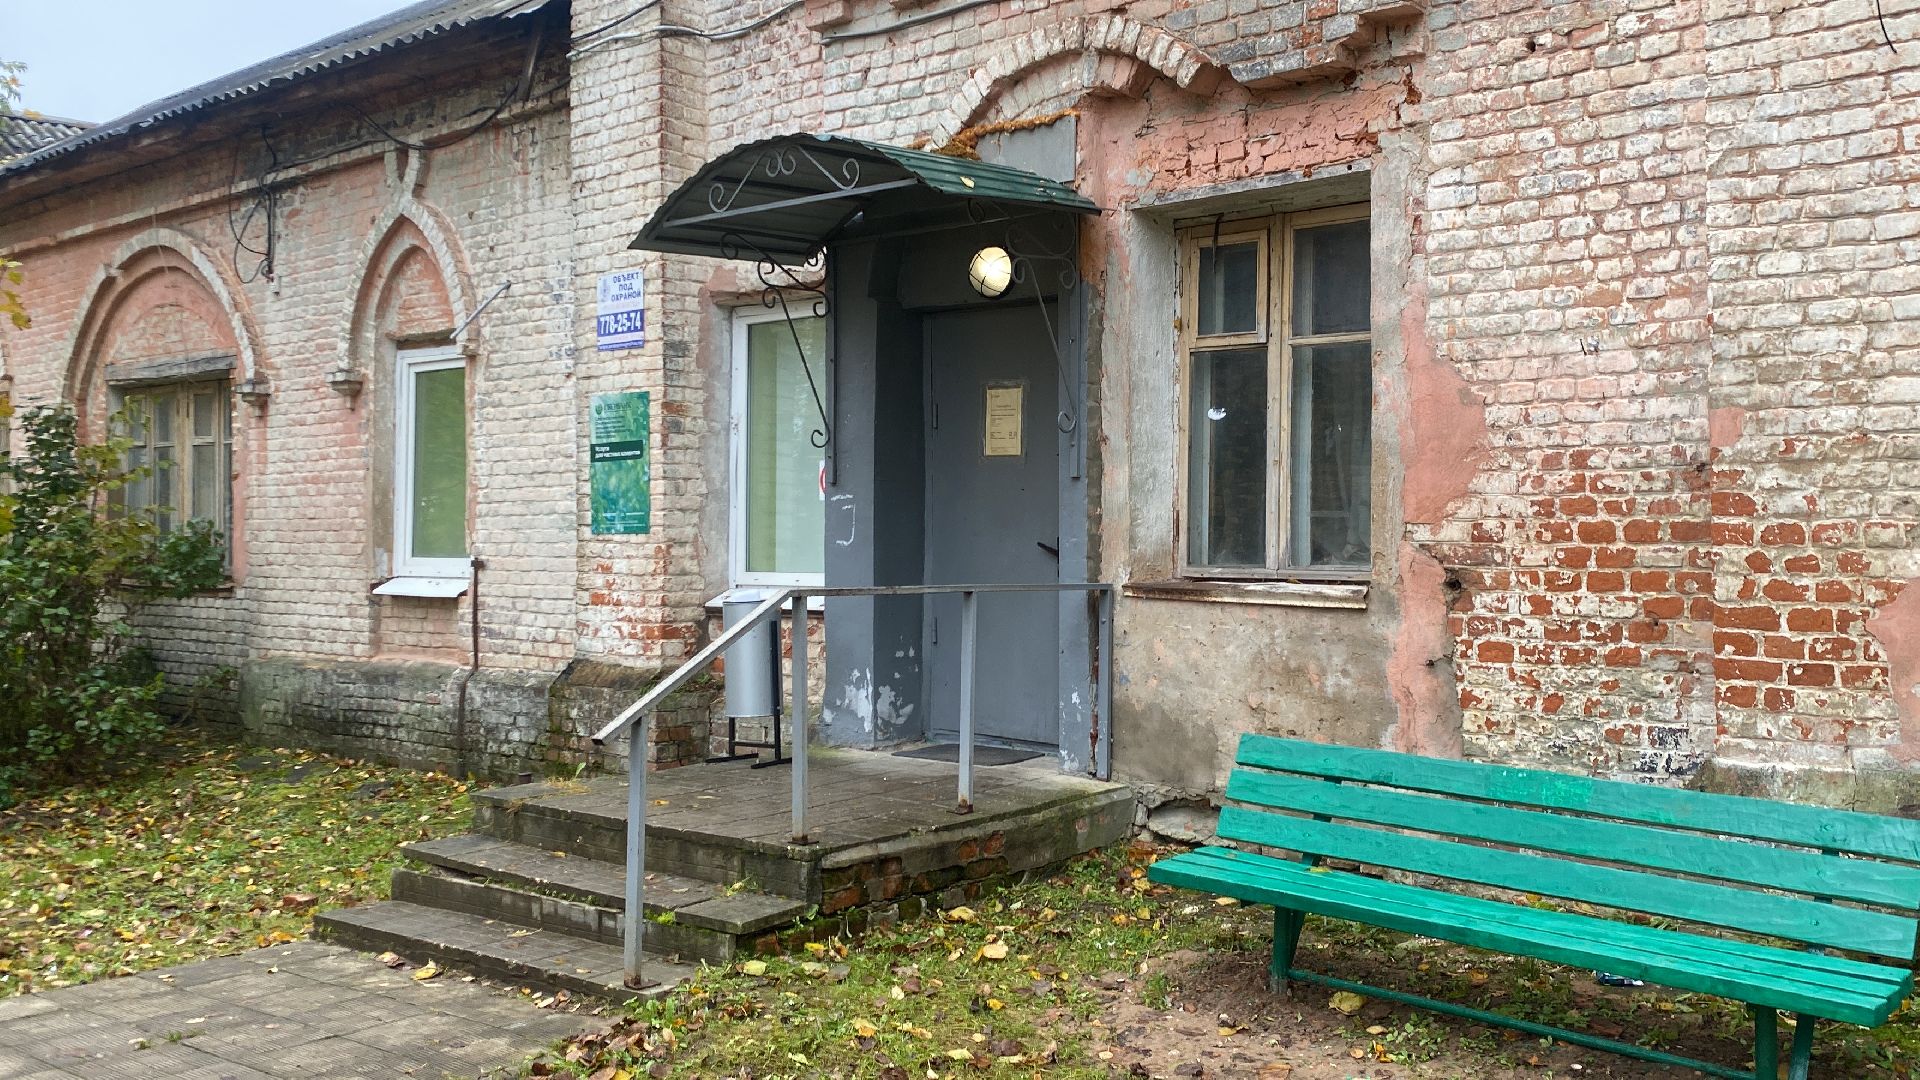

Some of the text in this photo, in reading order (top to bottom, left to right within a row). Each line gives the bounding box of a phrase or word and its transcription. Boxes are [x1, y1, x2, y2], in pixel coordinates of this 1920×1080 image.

[613, 272, 639, 283] ОБЪЕКТ
[618, 283, 634, 292] ПОД
[611, 290, 641, 302] ОХРАНОЙ
[600, 312, 641, 334] 778-25-74
